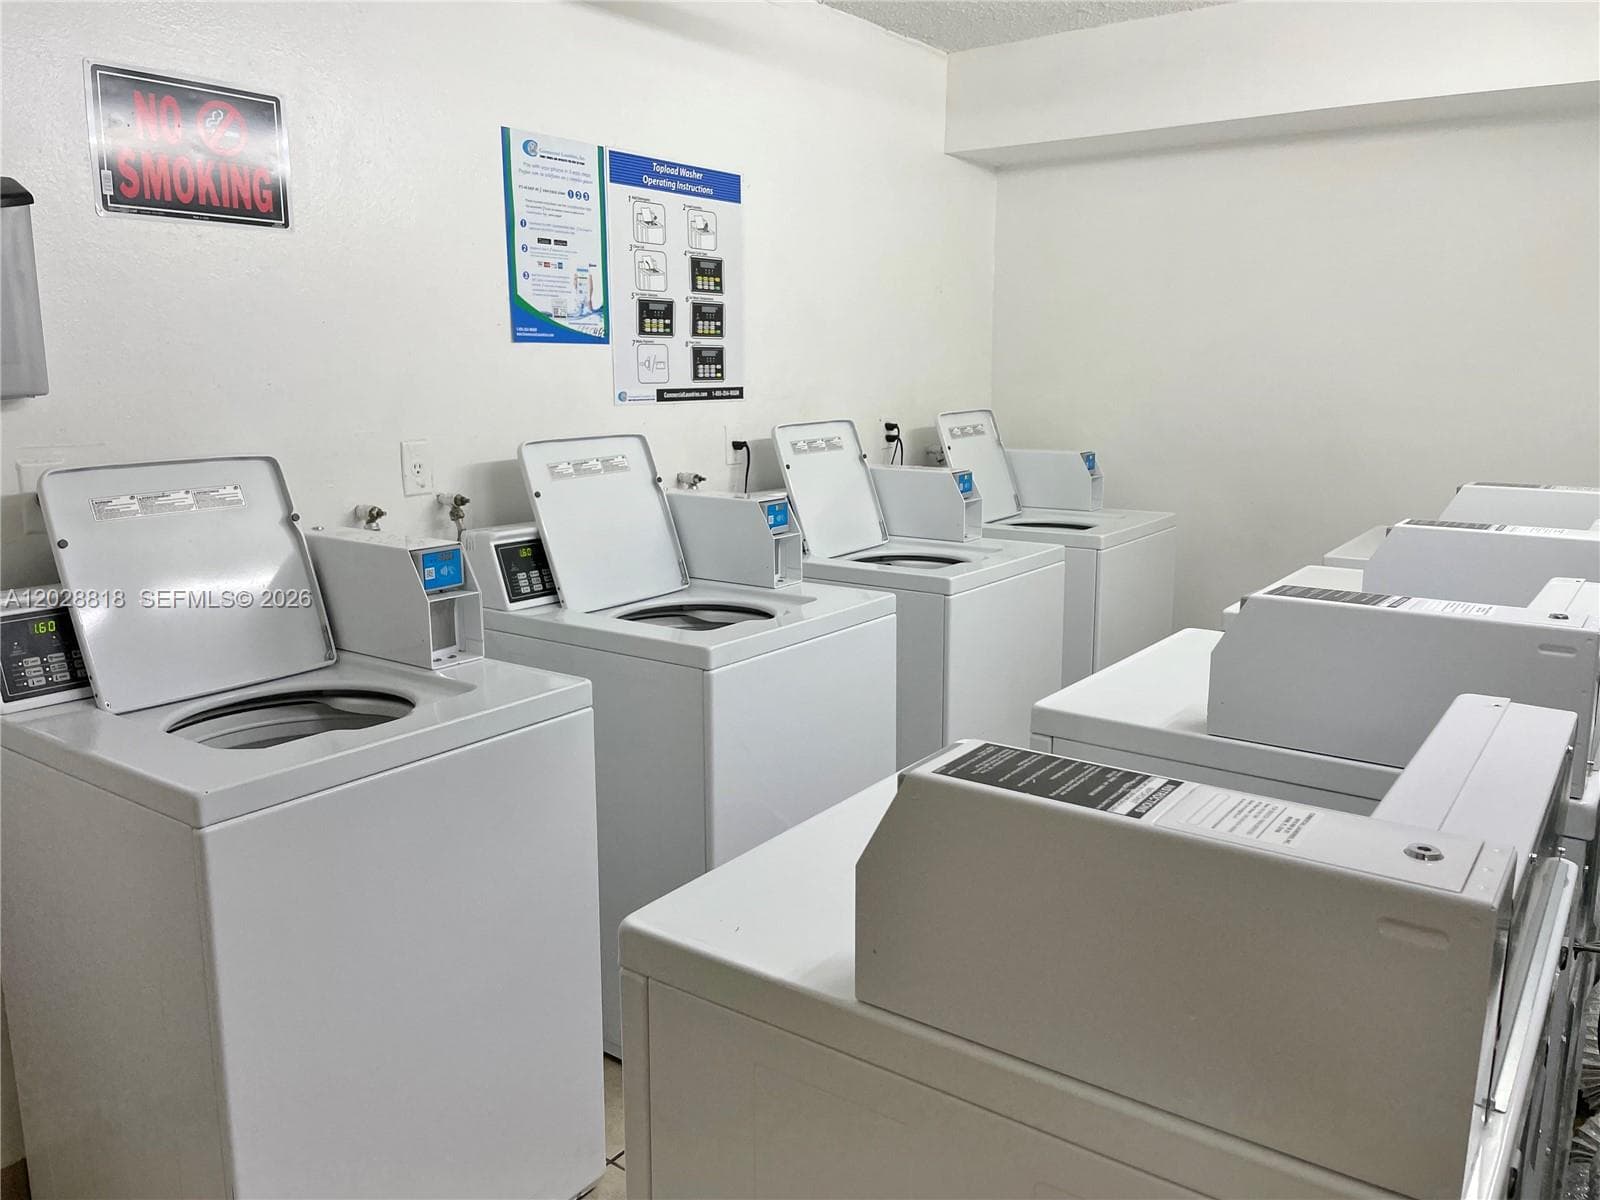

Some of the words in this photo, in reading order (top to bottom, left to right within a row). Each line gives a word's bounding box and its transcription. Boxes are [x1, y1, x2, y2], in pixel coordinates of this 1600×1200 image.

[132, 90, 182, 145] NO
[116, 147, 273, 213] SMOKING
[642, 175, 676, 190] Operating
[677, 180, 714, 195] Instructions
[652, 162, 679, 176] Topload
[680, 166, 703, 180] Washer
